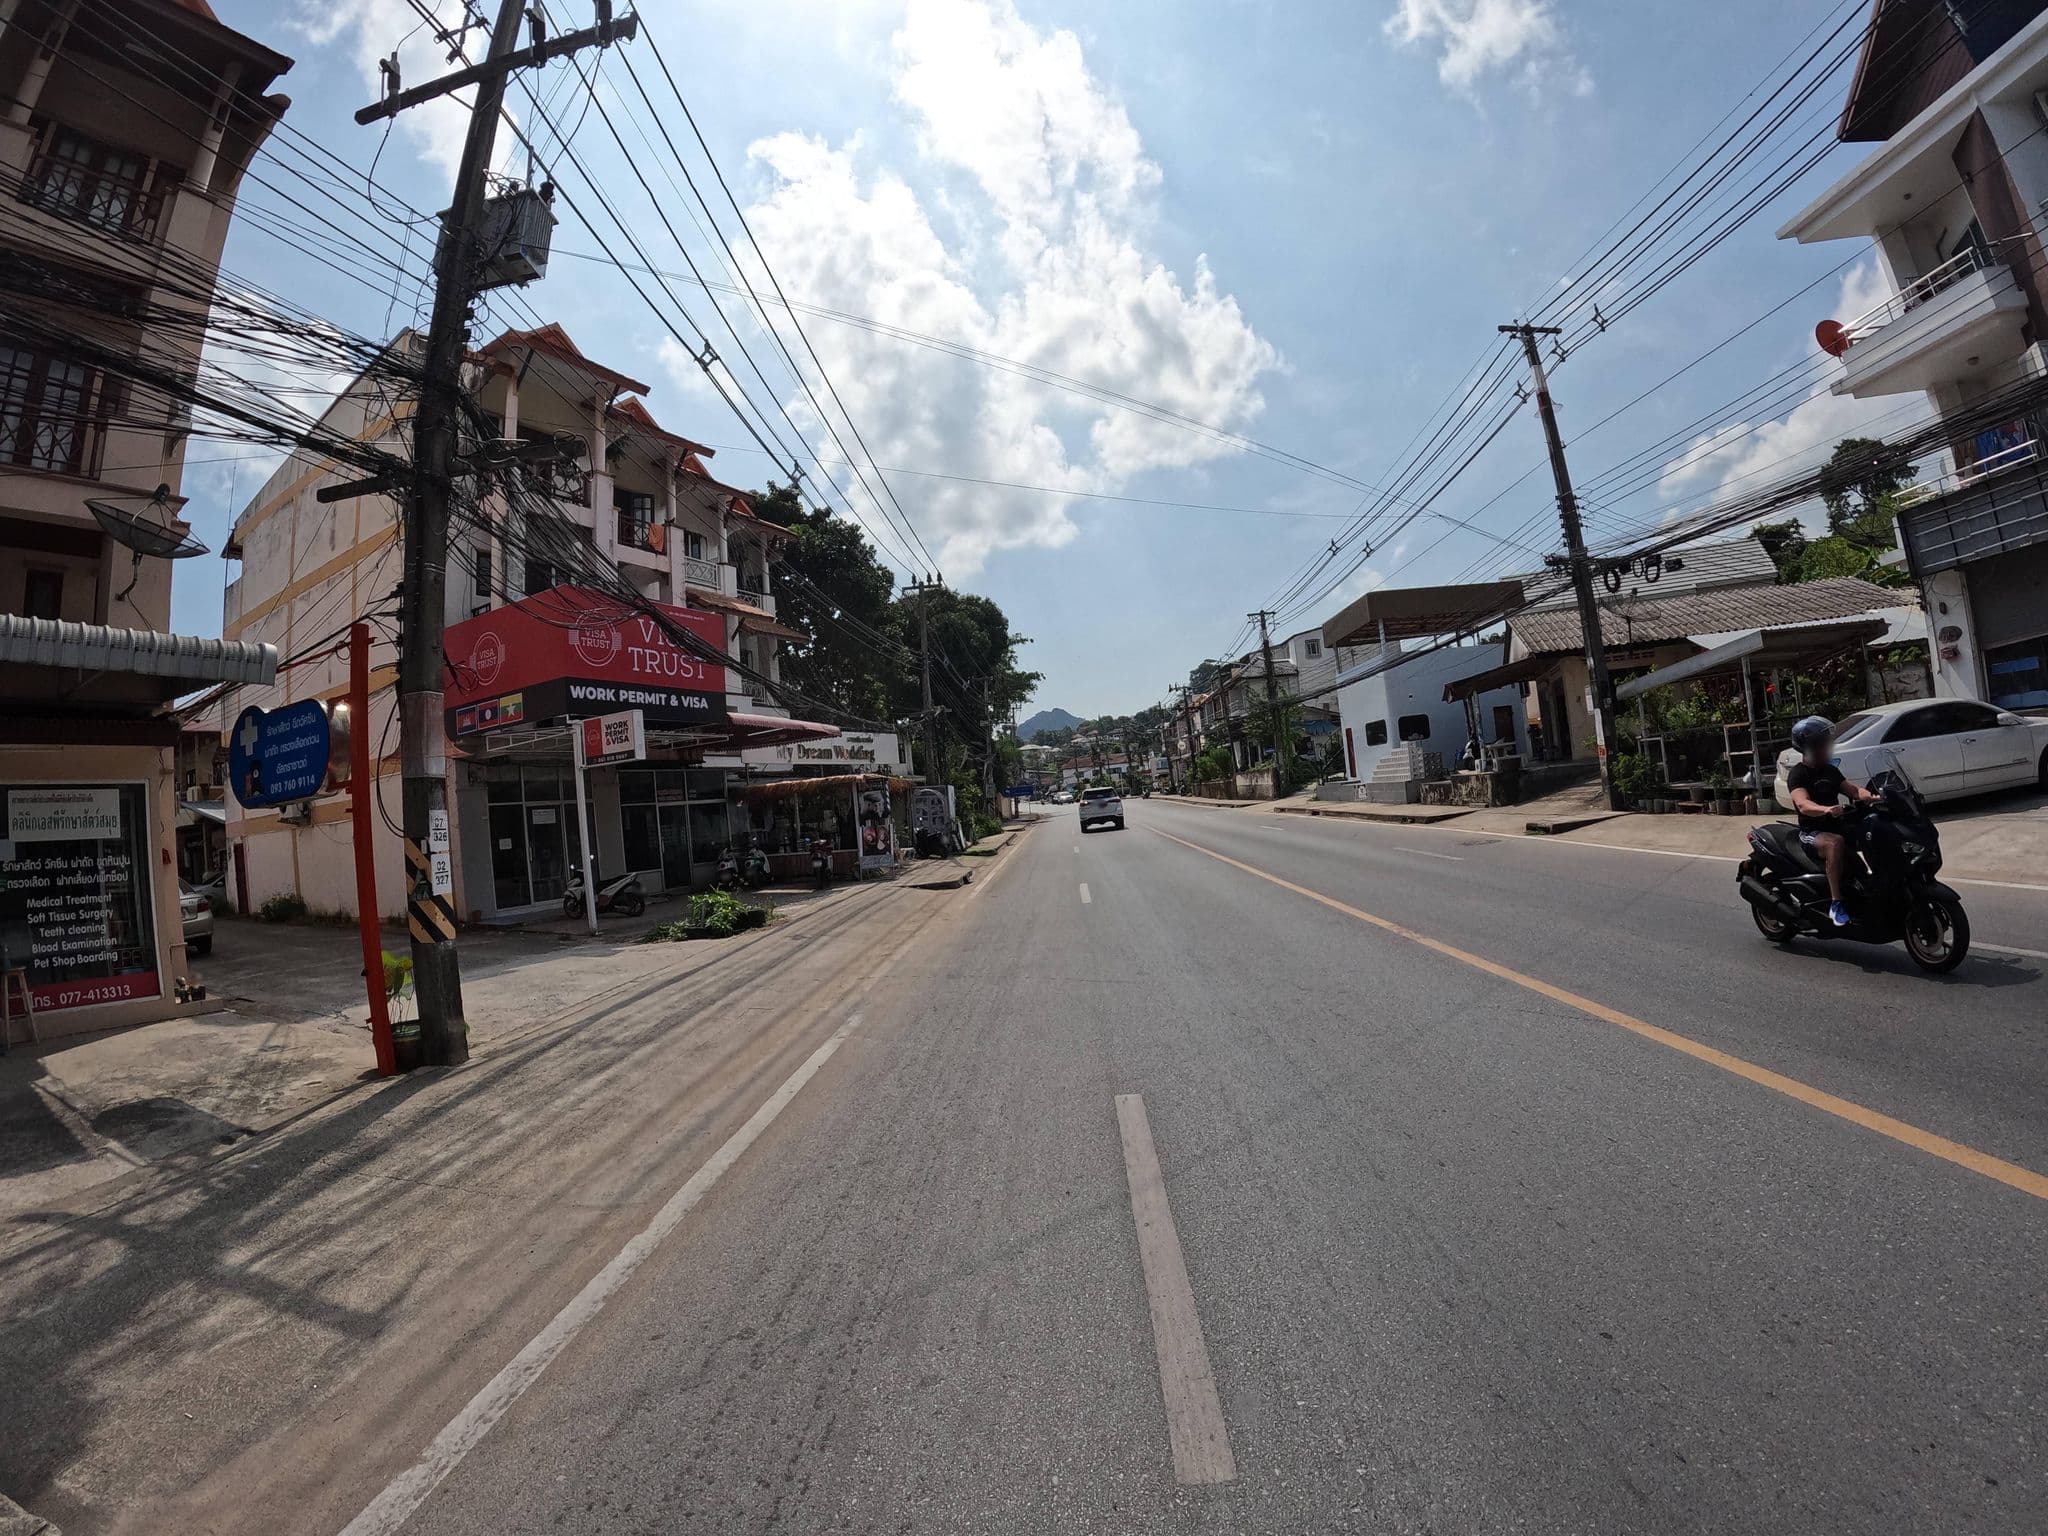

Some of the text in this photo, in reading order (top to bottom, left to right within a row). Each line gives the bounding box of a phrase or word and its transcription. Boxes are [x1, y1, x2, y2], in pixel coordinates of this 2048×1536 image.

[585, 630, 606, 639] VISA
[580, 637, 611, 649] TRUST
[480, 648, 496, 659] VISA
[477, 656, 497, 670] TRUST
[627, 646, 707, 680] TRUST
[569, 685, 709, 710] WORK PERMIT & VISA
[605, 720, 629, 731] WORK
[605, 728, 629, 738] PERMIT
[798, 744, 833, 761] Dream
[833, 745, 876, 763] Wedding
[270, 774, 316, 794] 093 760 9114
[435, 874, 449, 886] 327
[26, 892, 112, 908] Medical Treatment
[27, 908, 113, 924] Soft Tissue Surgery
[40, 922, 107, 938] Teeth cleaning
[32, 937, 118, 954] Blood Examination
[34, 950, 118, 969] Pet Shop Boarding
[60, 984, 132, 1006] 077-413313
